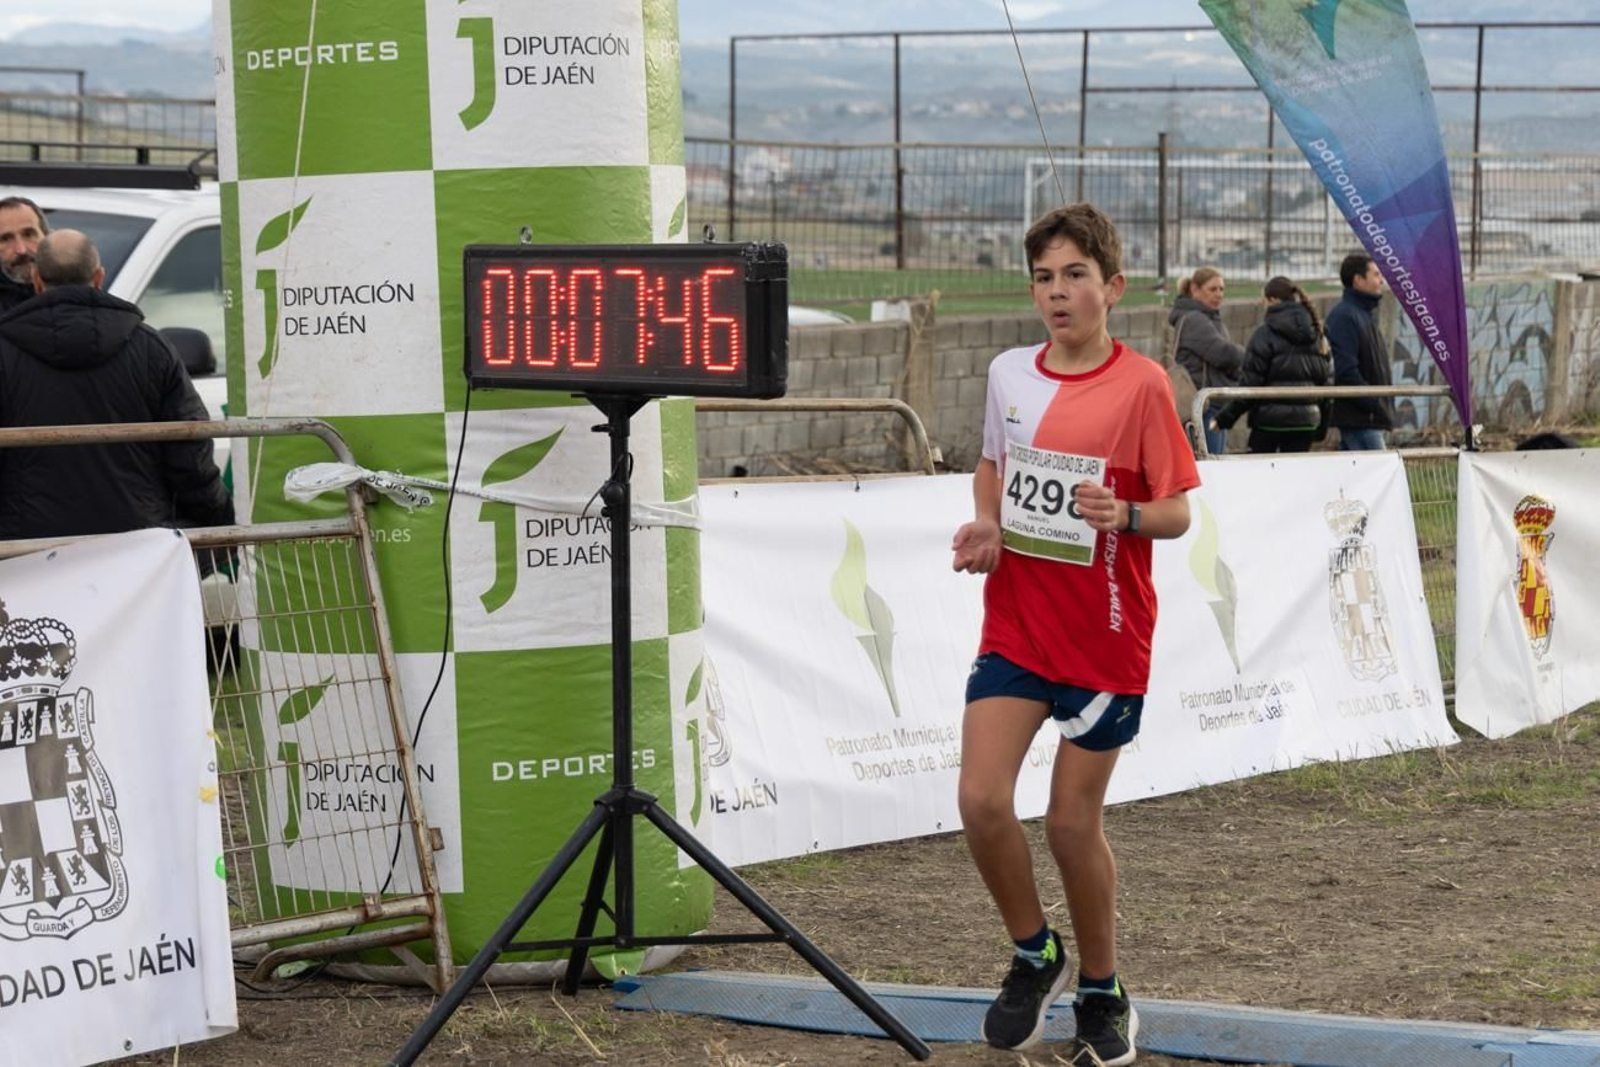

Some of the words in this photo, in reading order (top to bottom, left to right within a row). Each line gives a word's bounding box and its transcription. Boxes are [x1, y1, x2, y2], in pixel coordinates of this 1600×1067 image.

[247, 41, 399, 70] DEPORTES
[503, 33, 630, 55] DIPUTACIÓN
[505, 65, 537, 86] DE
[541, 62, 595, 85] JAÉN
[1308, 137, 1451, 363] patronatodeportesjaen.es
[283, 279, 414, 306] DIPUTACIÓN
[285, 316, 309, 336] DE
[313, 311, 366, 335] JAÉN
[526, 515, 651, 538] DIPUTA
[1007, 518, 1036, 534] LAGUNA
[1038, 527, 1080, 541] COMINO
[527, 548, 558, 568] DE
[1180, 688, 1233, 710] Patronato
[1384, 692, 1403, 712] DE
[1199, 709, 1246, 733] Deportes
[826, 732, 893, 757] Patronato
[893, 722, 959, 748] Municipal
[851, 757, 917, 785] Deportes
[919, 752, 936, 773] de
[939, 746, 962, 770] Jaé
[306, 791, 329, 812] DE
[333, 789, 386, 813] JAÉN
[732, 778, 778, 811] JAÉN
[33, 922, 69, 933] GUARDA
[69, 918, 75, 928] Y
[0, 965, 66, 1008] DAD
[72, 953, 116, 991] DE
[124, 933, 196, 981] JAÉN
